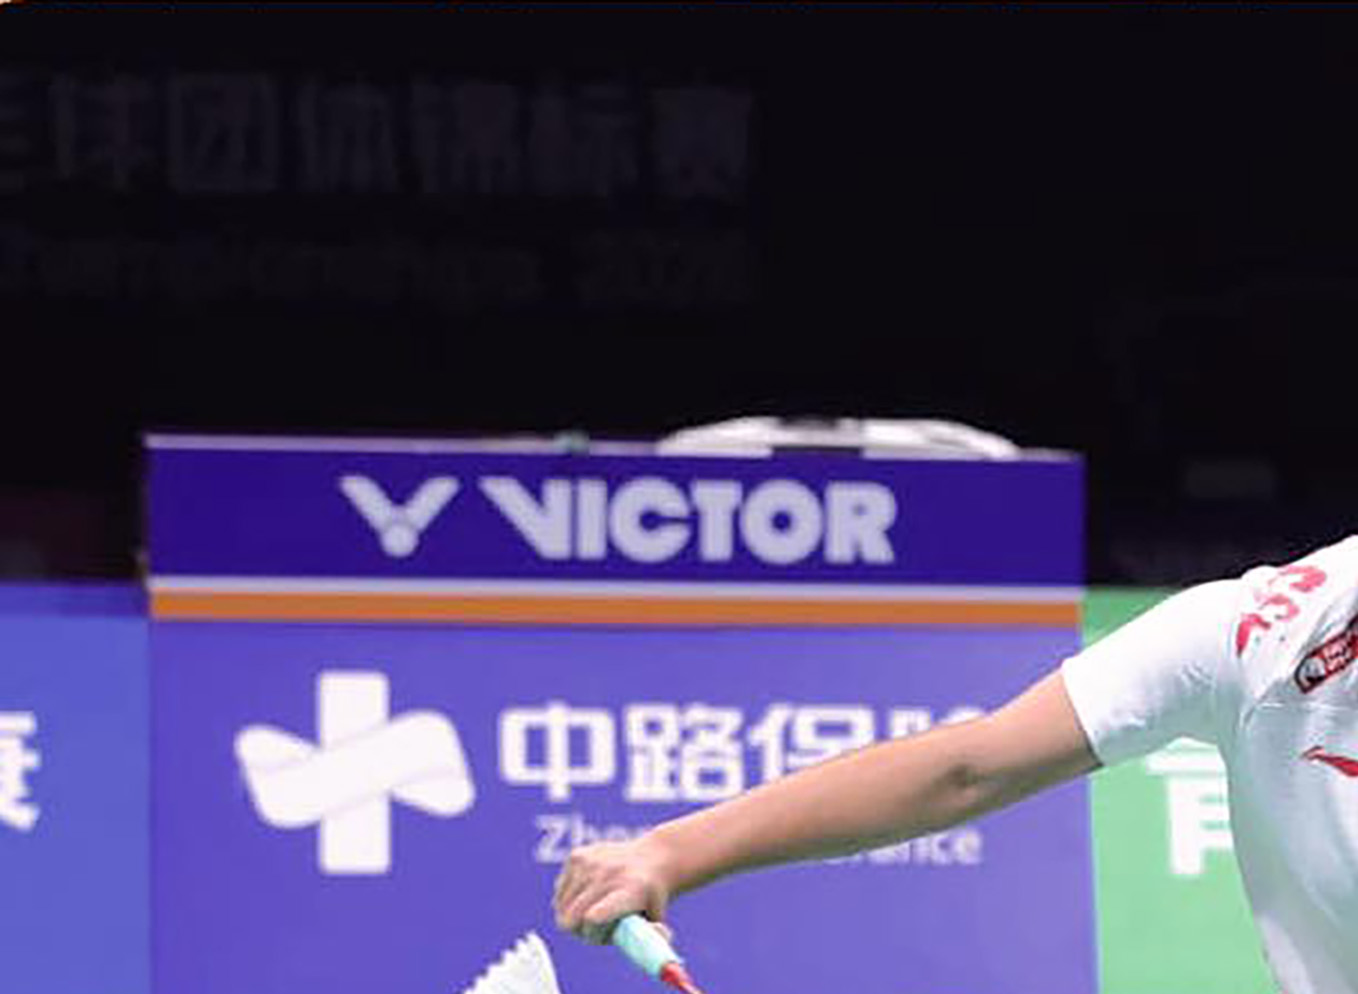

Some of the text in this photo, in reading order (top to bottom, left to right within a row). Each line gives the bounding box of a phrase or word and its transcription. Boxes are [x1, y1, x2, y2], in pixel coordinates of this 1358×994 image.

[0, 70, 753, 198] 球团体锦标赛
[477, 476, 898, 565] VICTOR
[500, 700, 988, 800] 中路保
